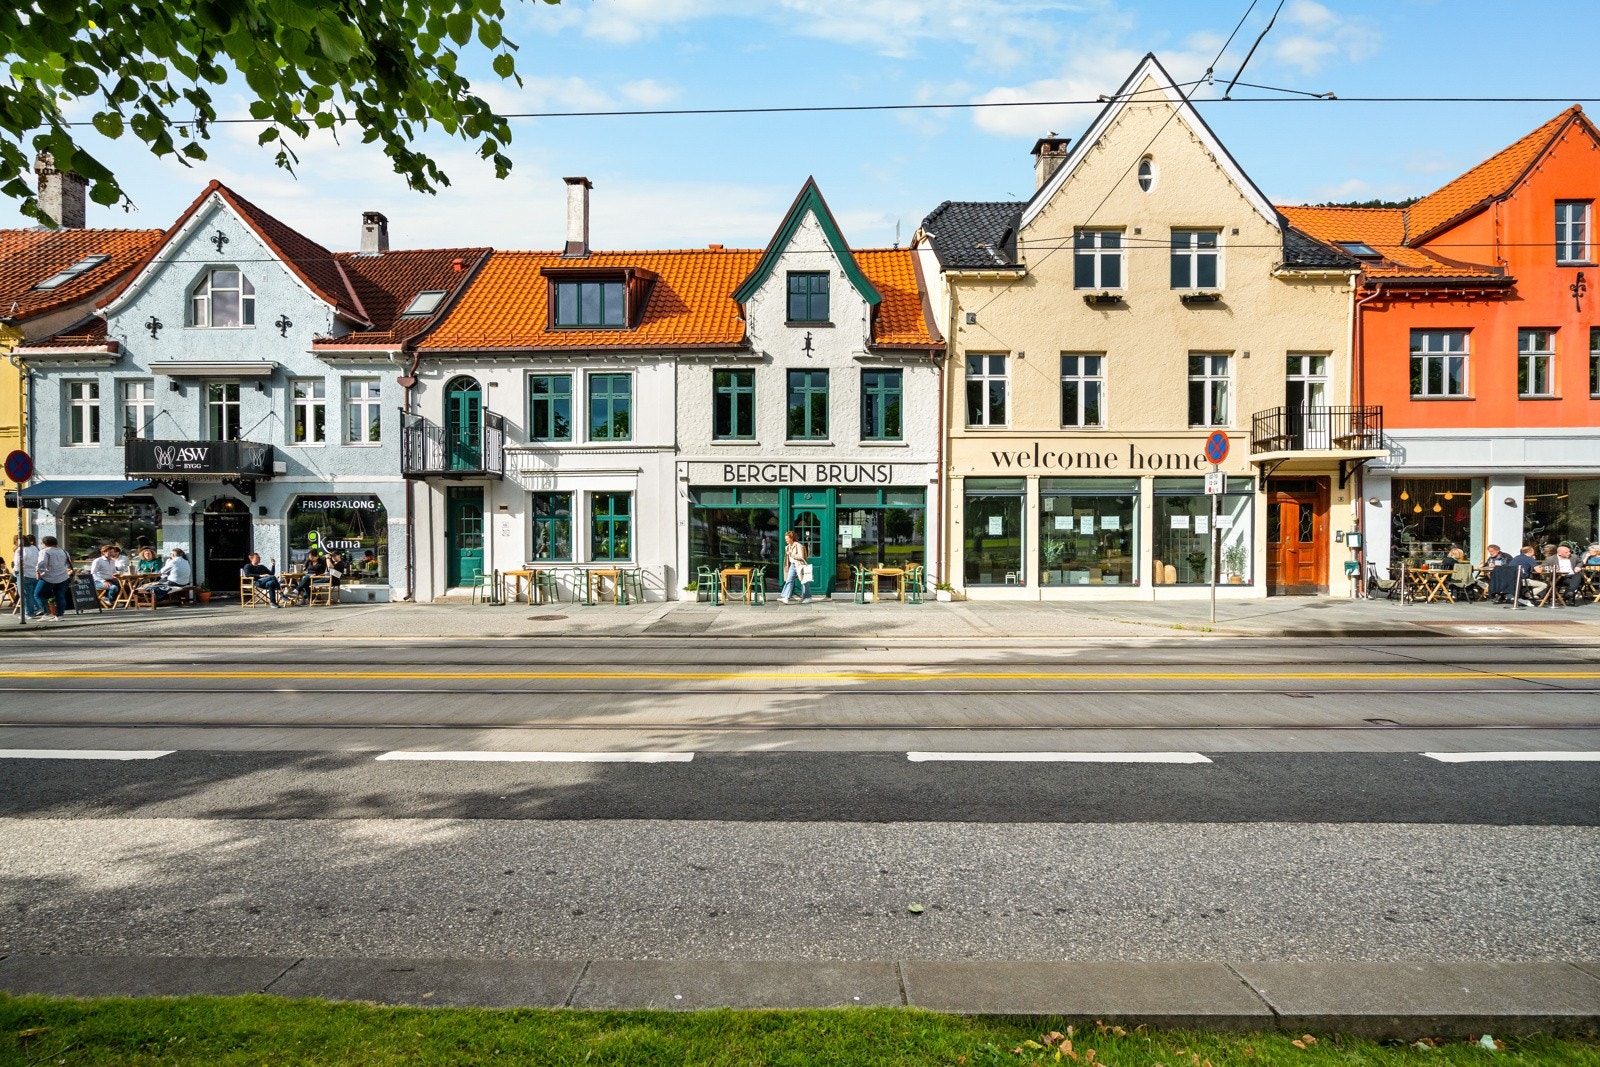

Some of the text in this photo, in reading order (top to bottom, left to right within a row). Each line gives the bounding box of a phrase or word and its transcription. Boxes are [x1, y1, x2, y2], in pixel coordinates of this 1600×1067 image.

[175, 447, 209, 462] ASW
[990, 442, 1207, 471] welcome home
[723, 464, 893, 484] BERGEN BRUNSJ
[302, 500, 375, 509] FRISØRSALONG
[316, 531, 361, 554] Karma
